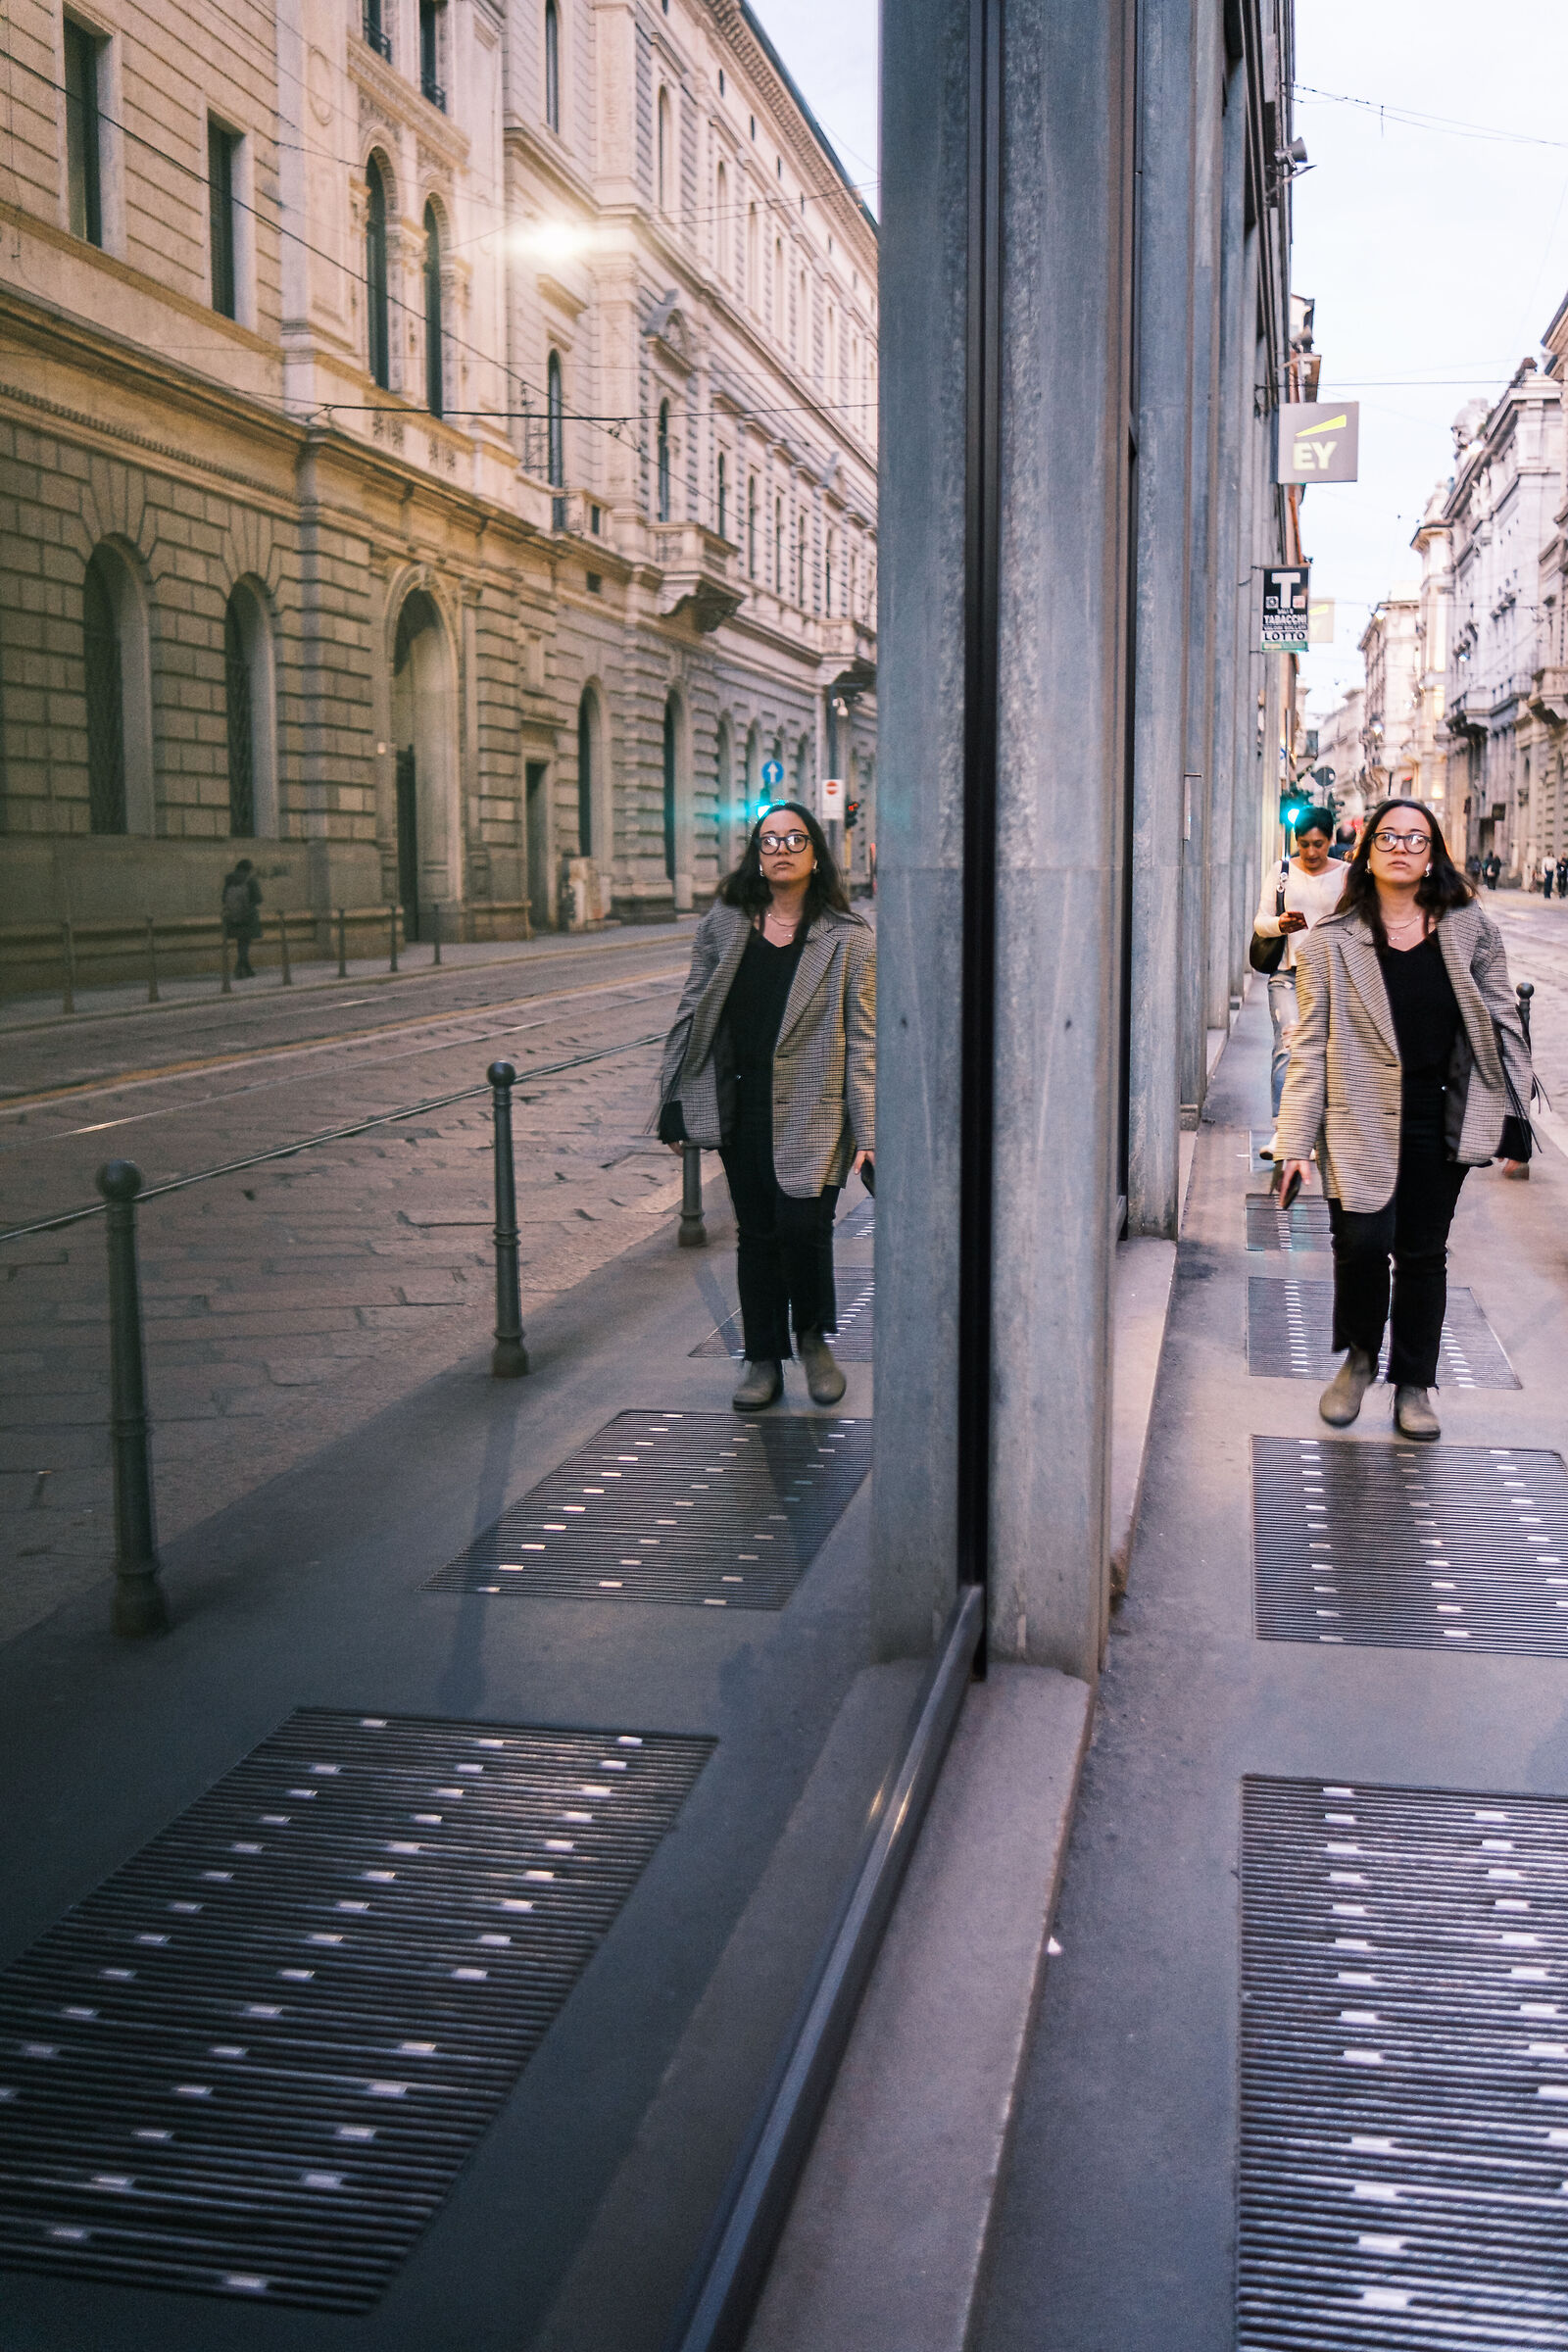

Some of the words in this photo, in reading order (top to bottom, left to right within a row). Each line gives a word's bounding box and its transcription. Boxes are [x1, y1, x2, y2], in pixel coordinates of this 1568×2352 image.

[1293, 441, 1338, 469] EY
[1271, 572, 1300, 608] T
[1264, 631, 1305, 641] LOTTO
